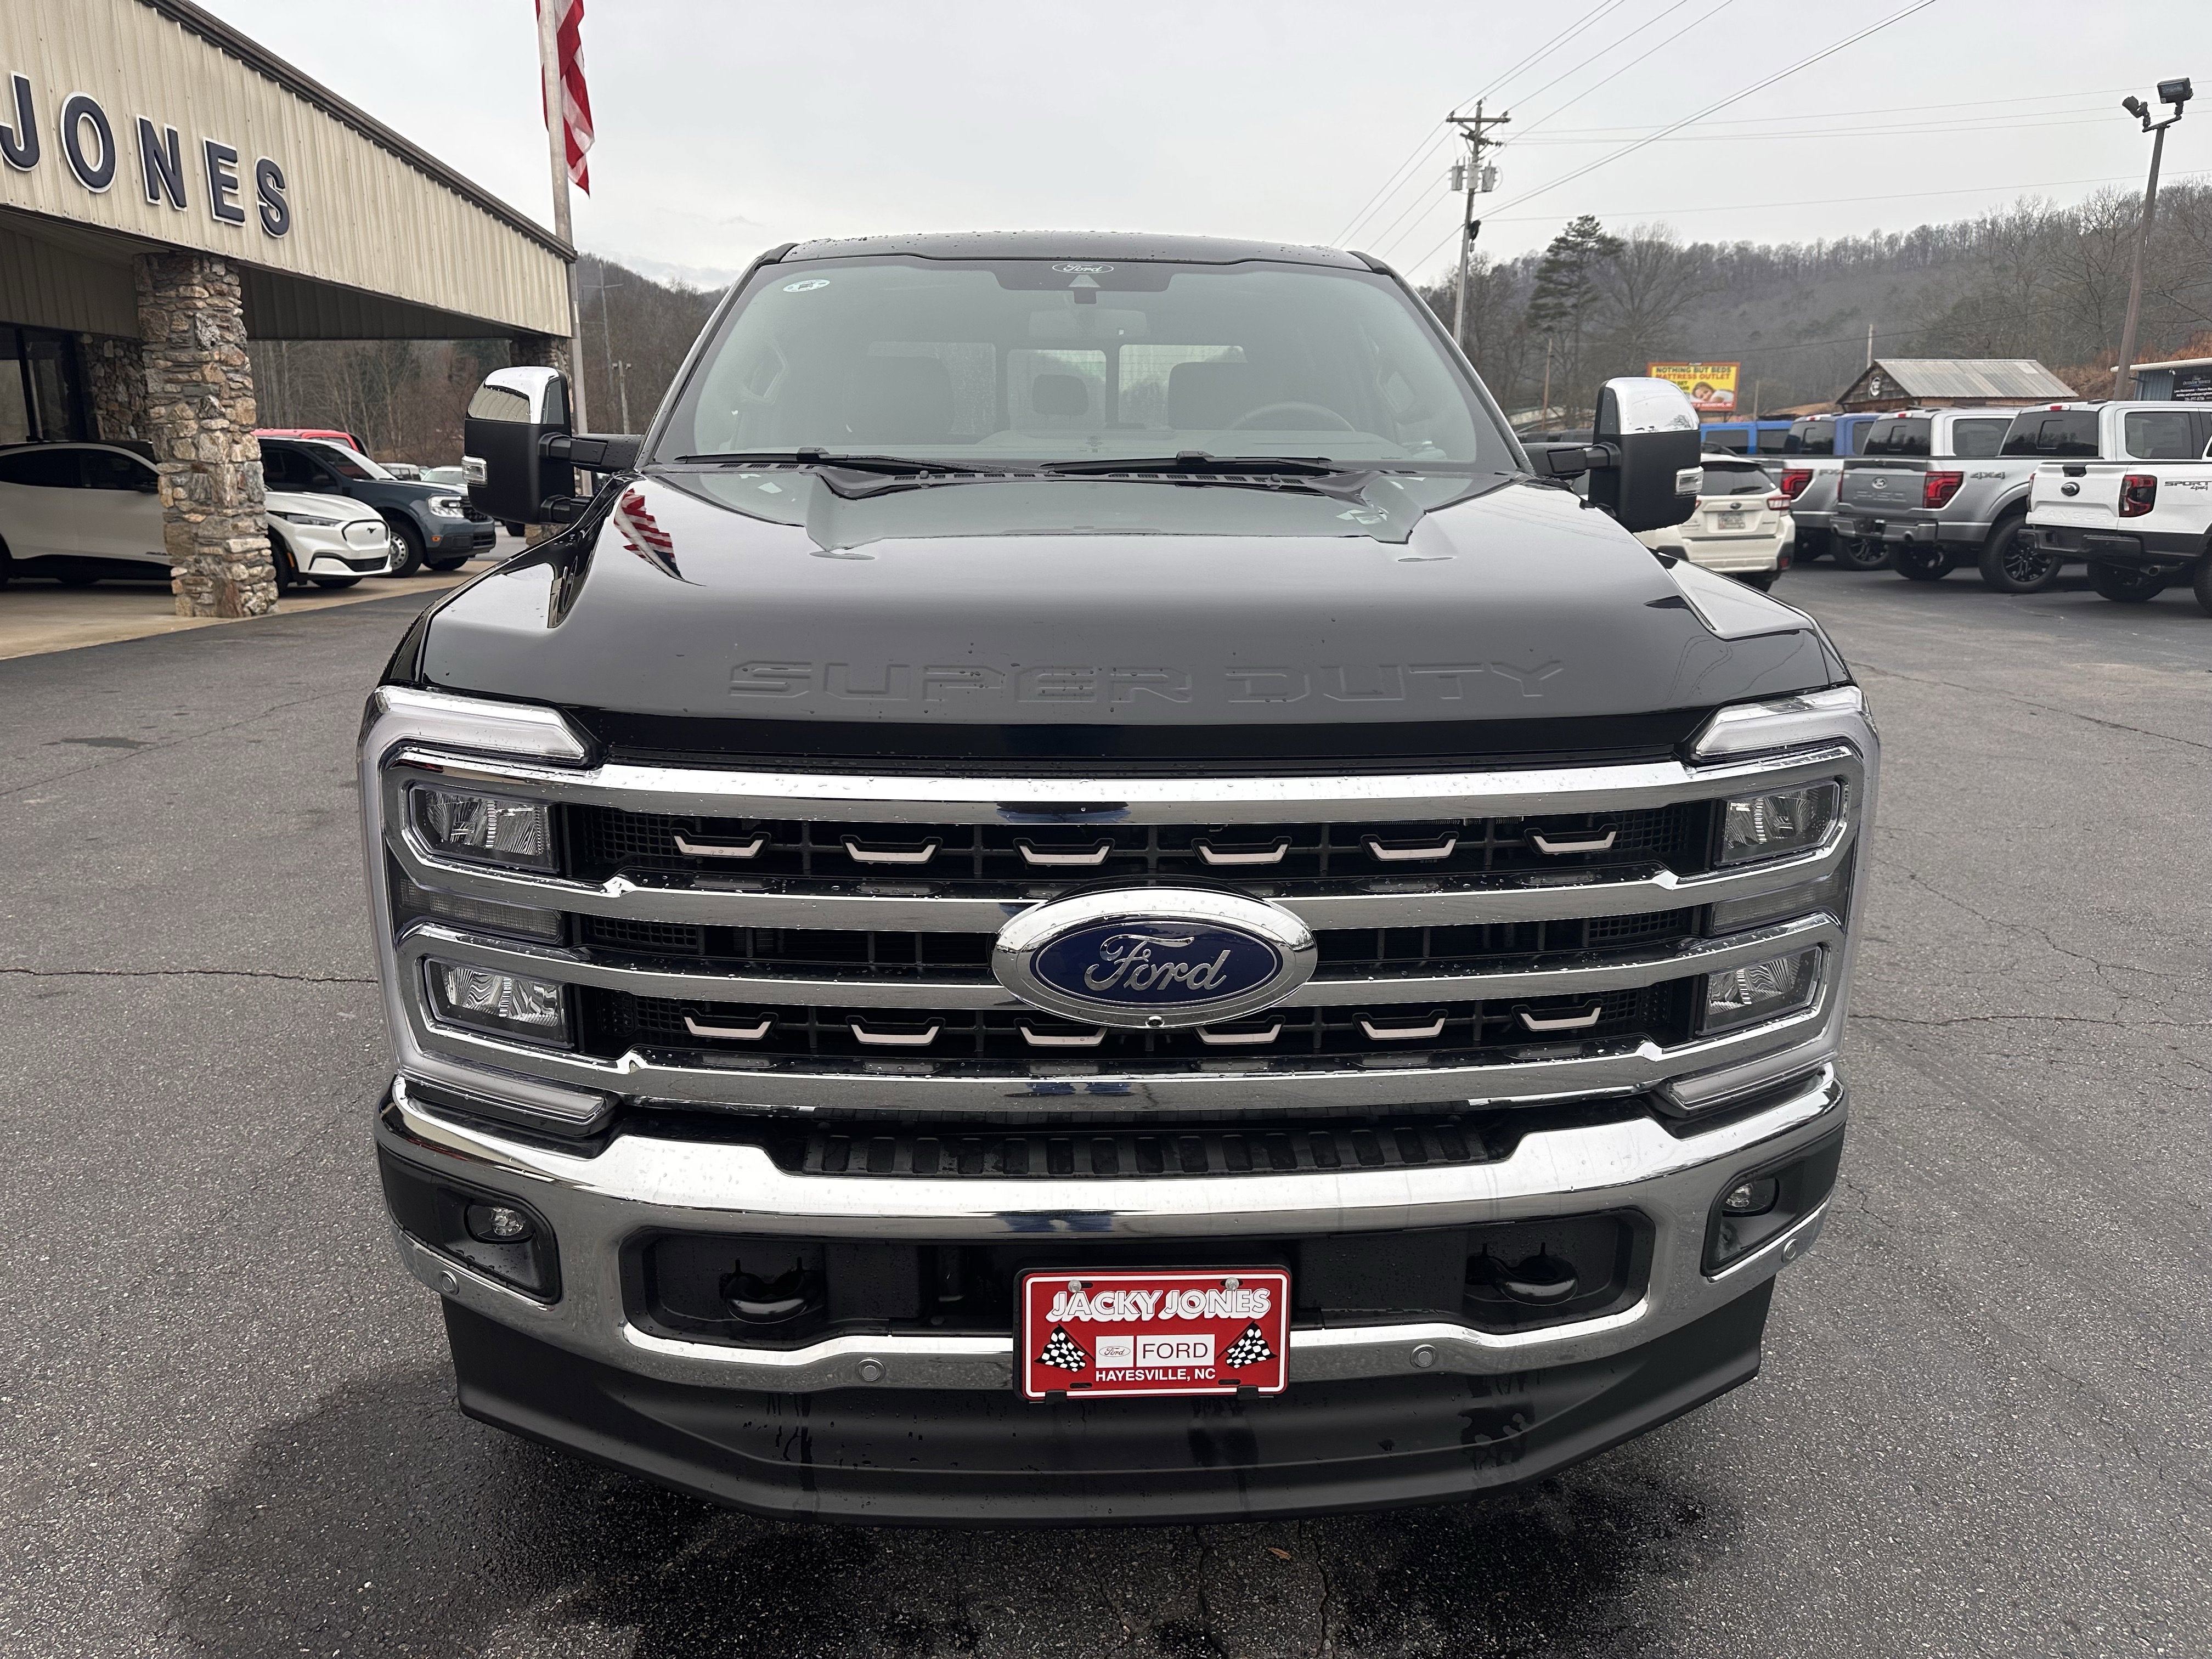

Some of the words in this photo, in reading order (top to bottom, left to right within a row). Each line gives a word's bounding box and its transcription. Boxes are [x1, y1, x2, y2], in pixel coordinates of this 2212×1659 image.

[0, 70, 290, 238] JONES
[1063, 263, 1103, 272] Ford
[728, 660, 1192, 703] SUPER
[1224, 660, 1564, 703] DUTY
[1084, 934, 1231, 991] Ford
[1045, 1290, 1163, 1322] JACKY
[1158, 1288, 1271, 1320] JONES
[1104, 1347, 1125, 1356] Ford
[1143, 1342, 1208, 1359] FORD
[1096, 1369, 1190, 1381] HAYESVILLE,
[1194, 1368, 1216, 1380] NC
